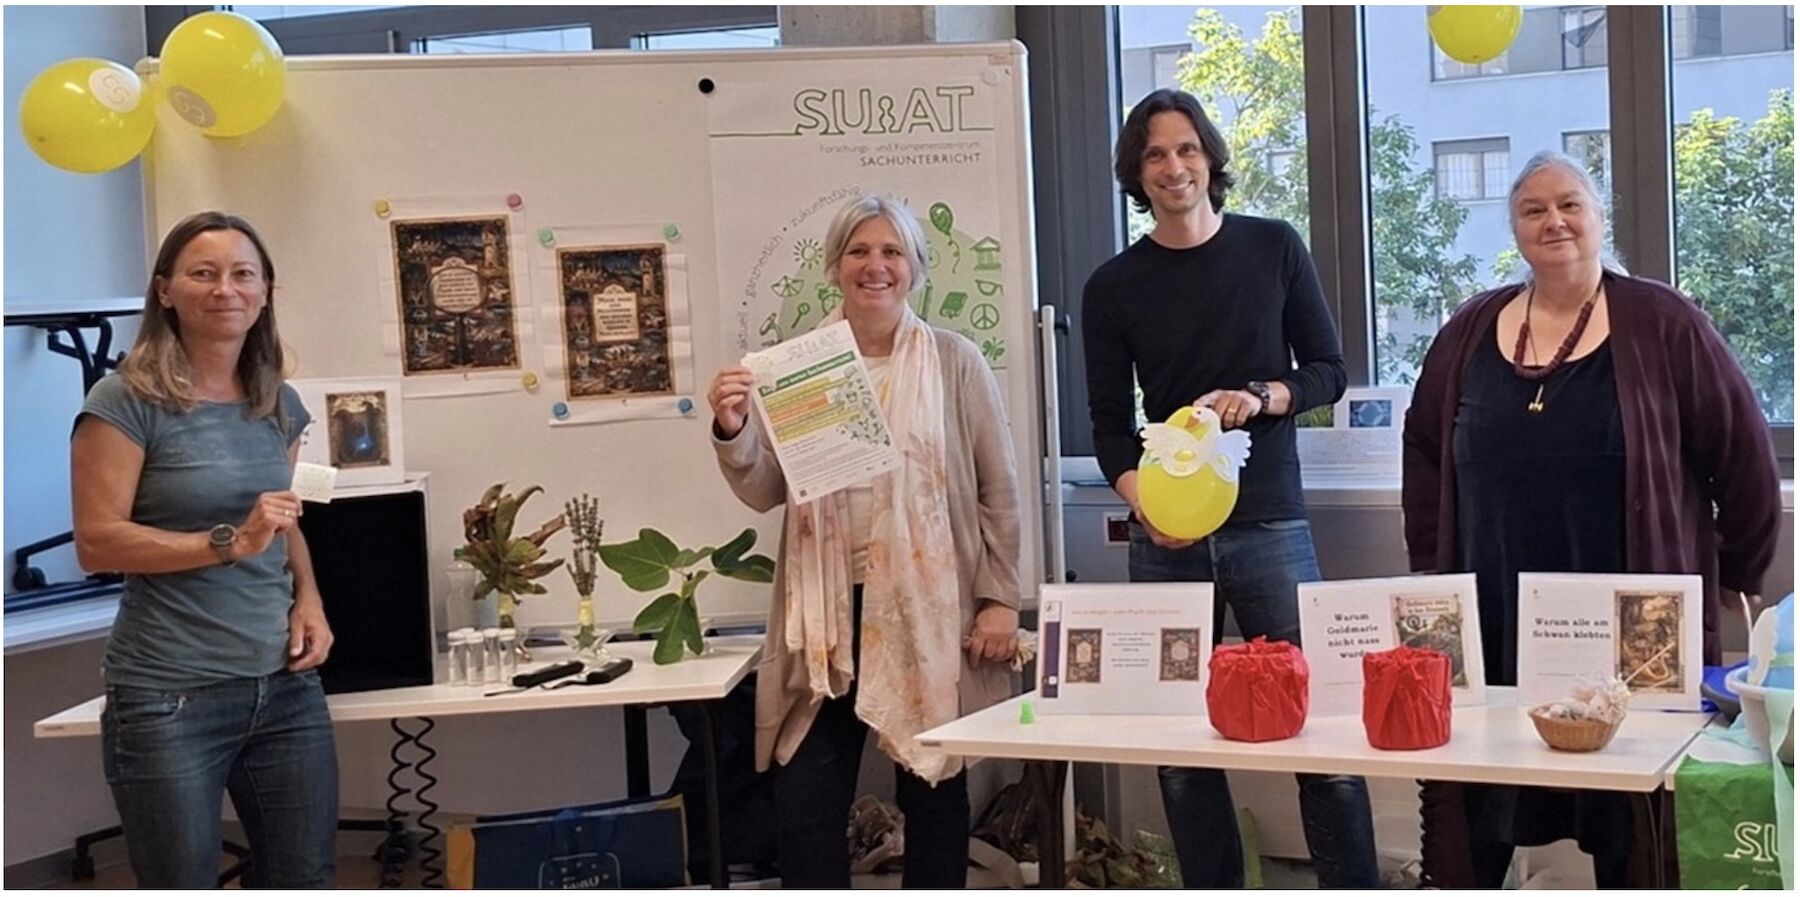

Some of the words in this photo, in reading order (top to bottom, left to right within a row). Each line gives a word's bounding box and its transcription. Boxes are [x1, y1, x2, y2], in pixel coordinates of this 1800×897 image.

[860, 152, 982, 167] SACHUNTERRICHT
[1334, 613, 1369, 622] Warum
[1535, 618, 1569, 626] Warum
[1573, 618, 1591, 626] alle
[1327, 625, 1379, 635] Goldmarie
[1533, 630, 1570, 639] Schwan
[1574, 630, 1611, 639] klebten
[1328, 638, 1355, 647] nicht
[1340, 650, 1364, 658] wurd
